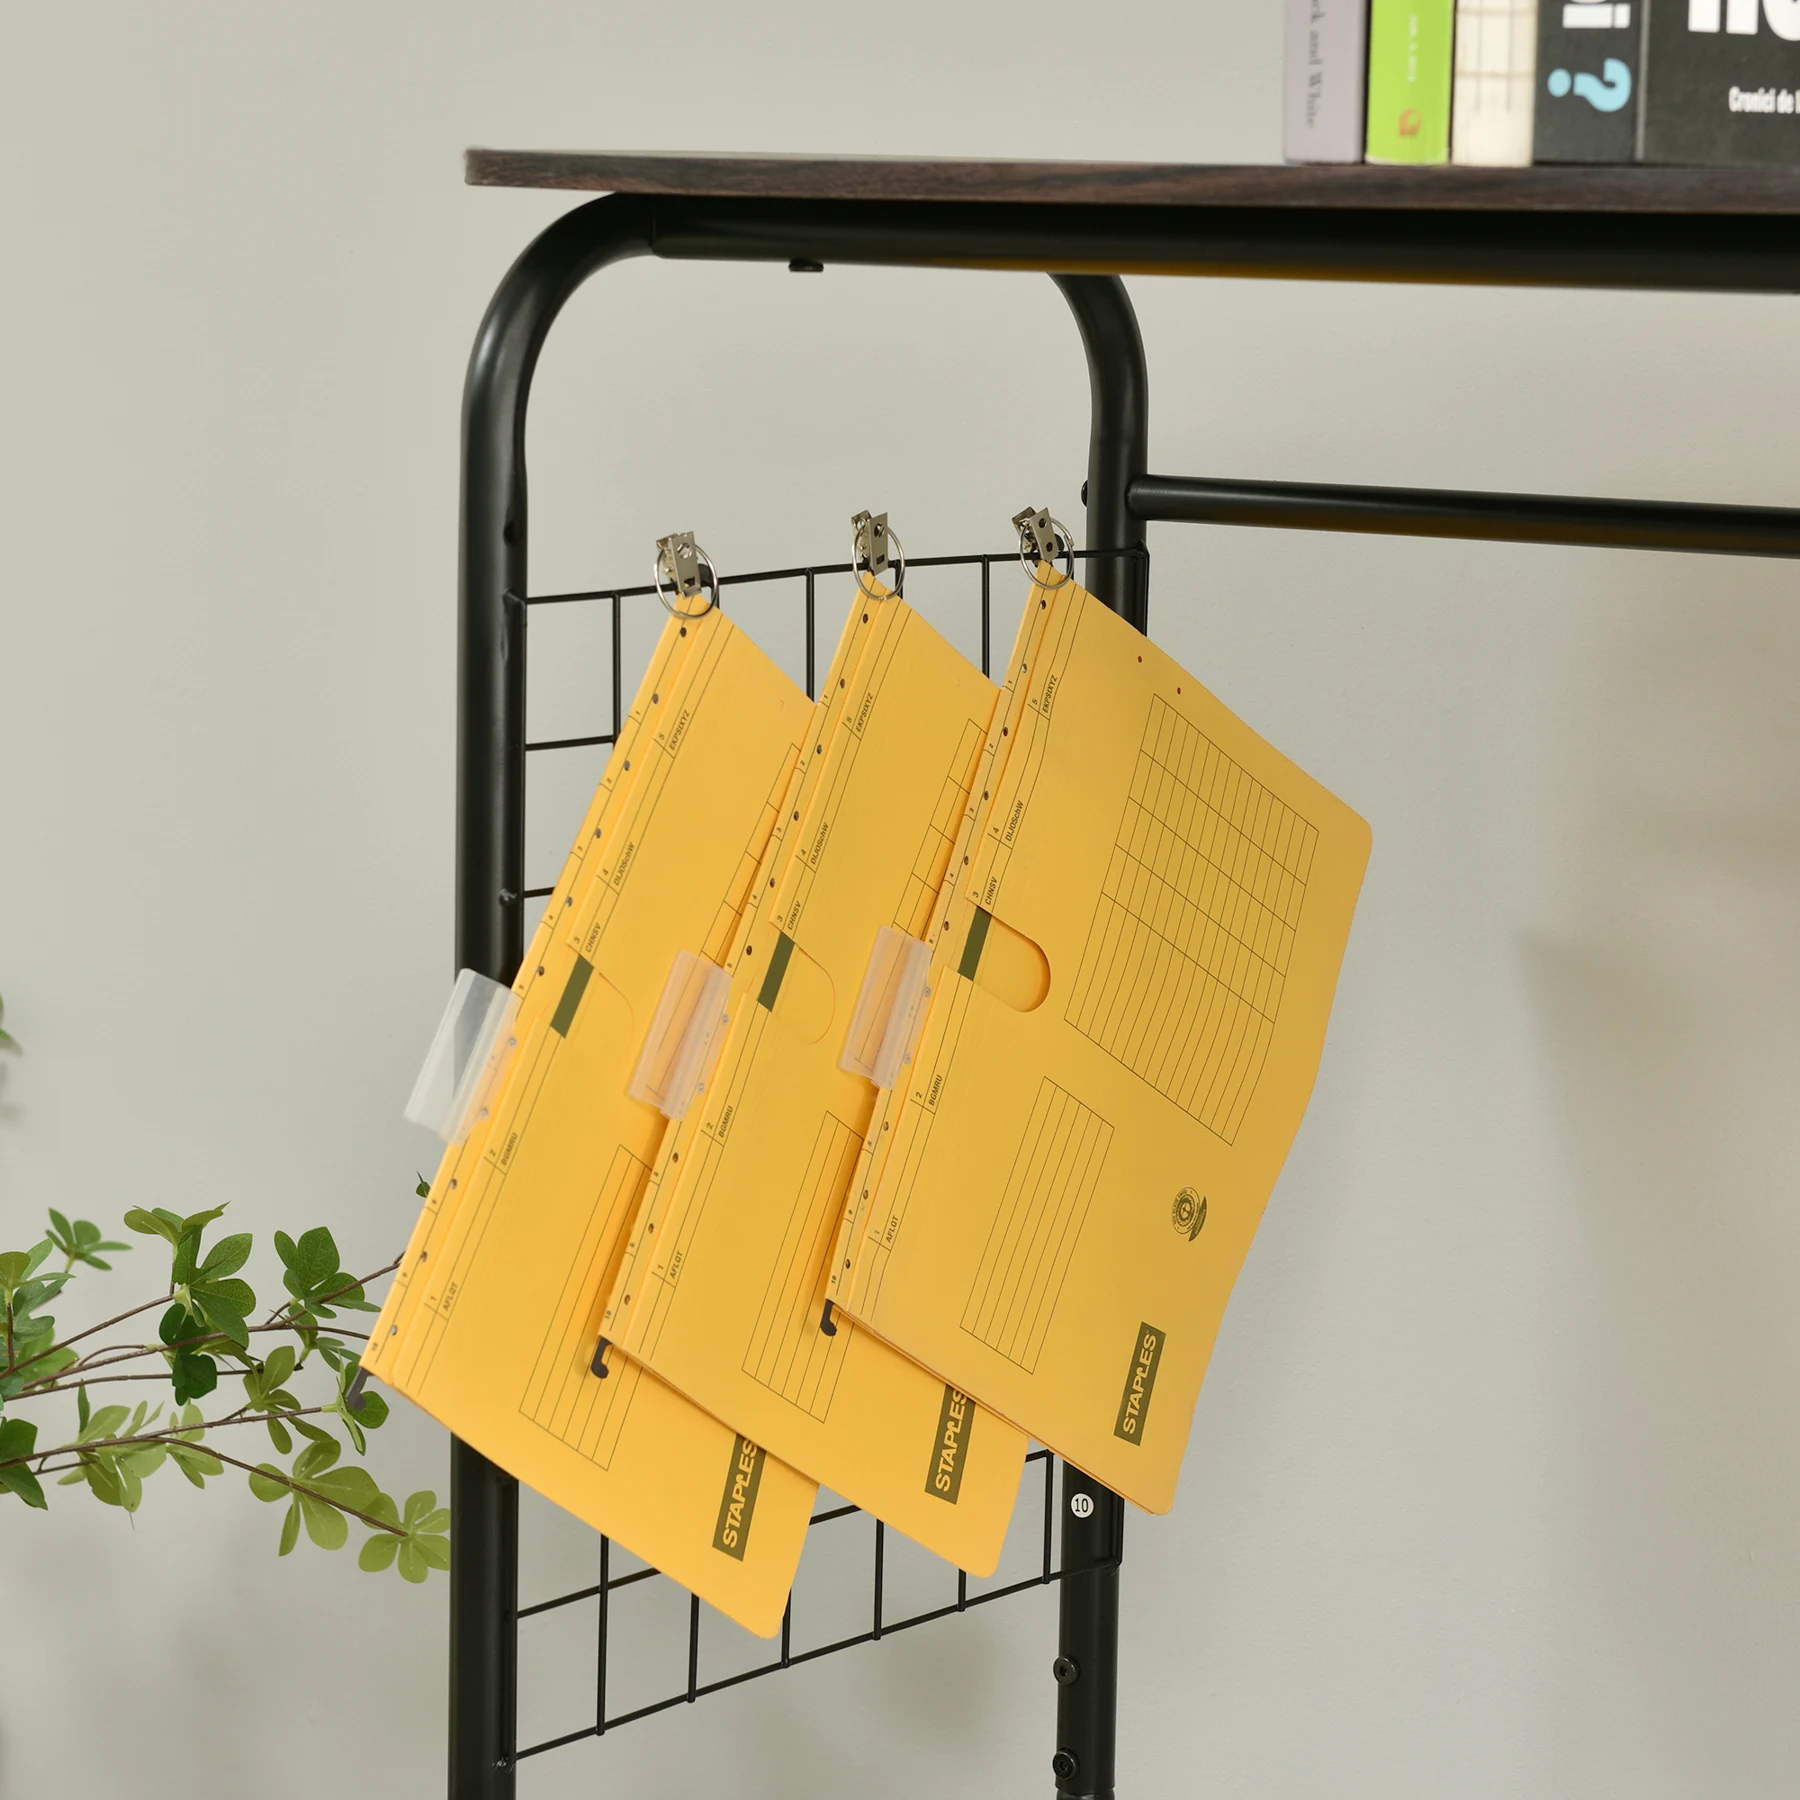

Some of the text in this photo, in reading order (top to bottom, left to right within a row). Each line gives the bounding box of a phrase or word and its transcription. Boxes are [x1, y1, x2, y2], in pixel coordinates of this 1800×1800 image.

[1309, 30, 1322, 65] and
[1306, 72, 1322, 128] White
[1728, 86, 1776, 113] Cronici
[659, 733, 666, 741] 5
[984, 876, 998, 906] CHNSV
[777, 914, 784, 922] 3
[786, 900, 802, 931] CHNSV
[585, 922, 602, 953] CHNSV
[928, 1074, 943, 1106] BGMRU
[707, 1122, 714, 1130] 2
[718, 1106, 734, 1138] BGMRU
[886, 1215, 899, 1244] AFLQT
[1123, 1332, 1157, 1435] STAPLES
[935, 1390, 967, 1492] STAPLES
[723, 1439, 758, 1548] STAPLES
[1074, 1498, 1088, 1514] 10
